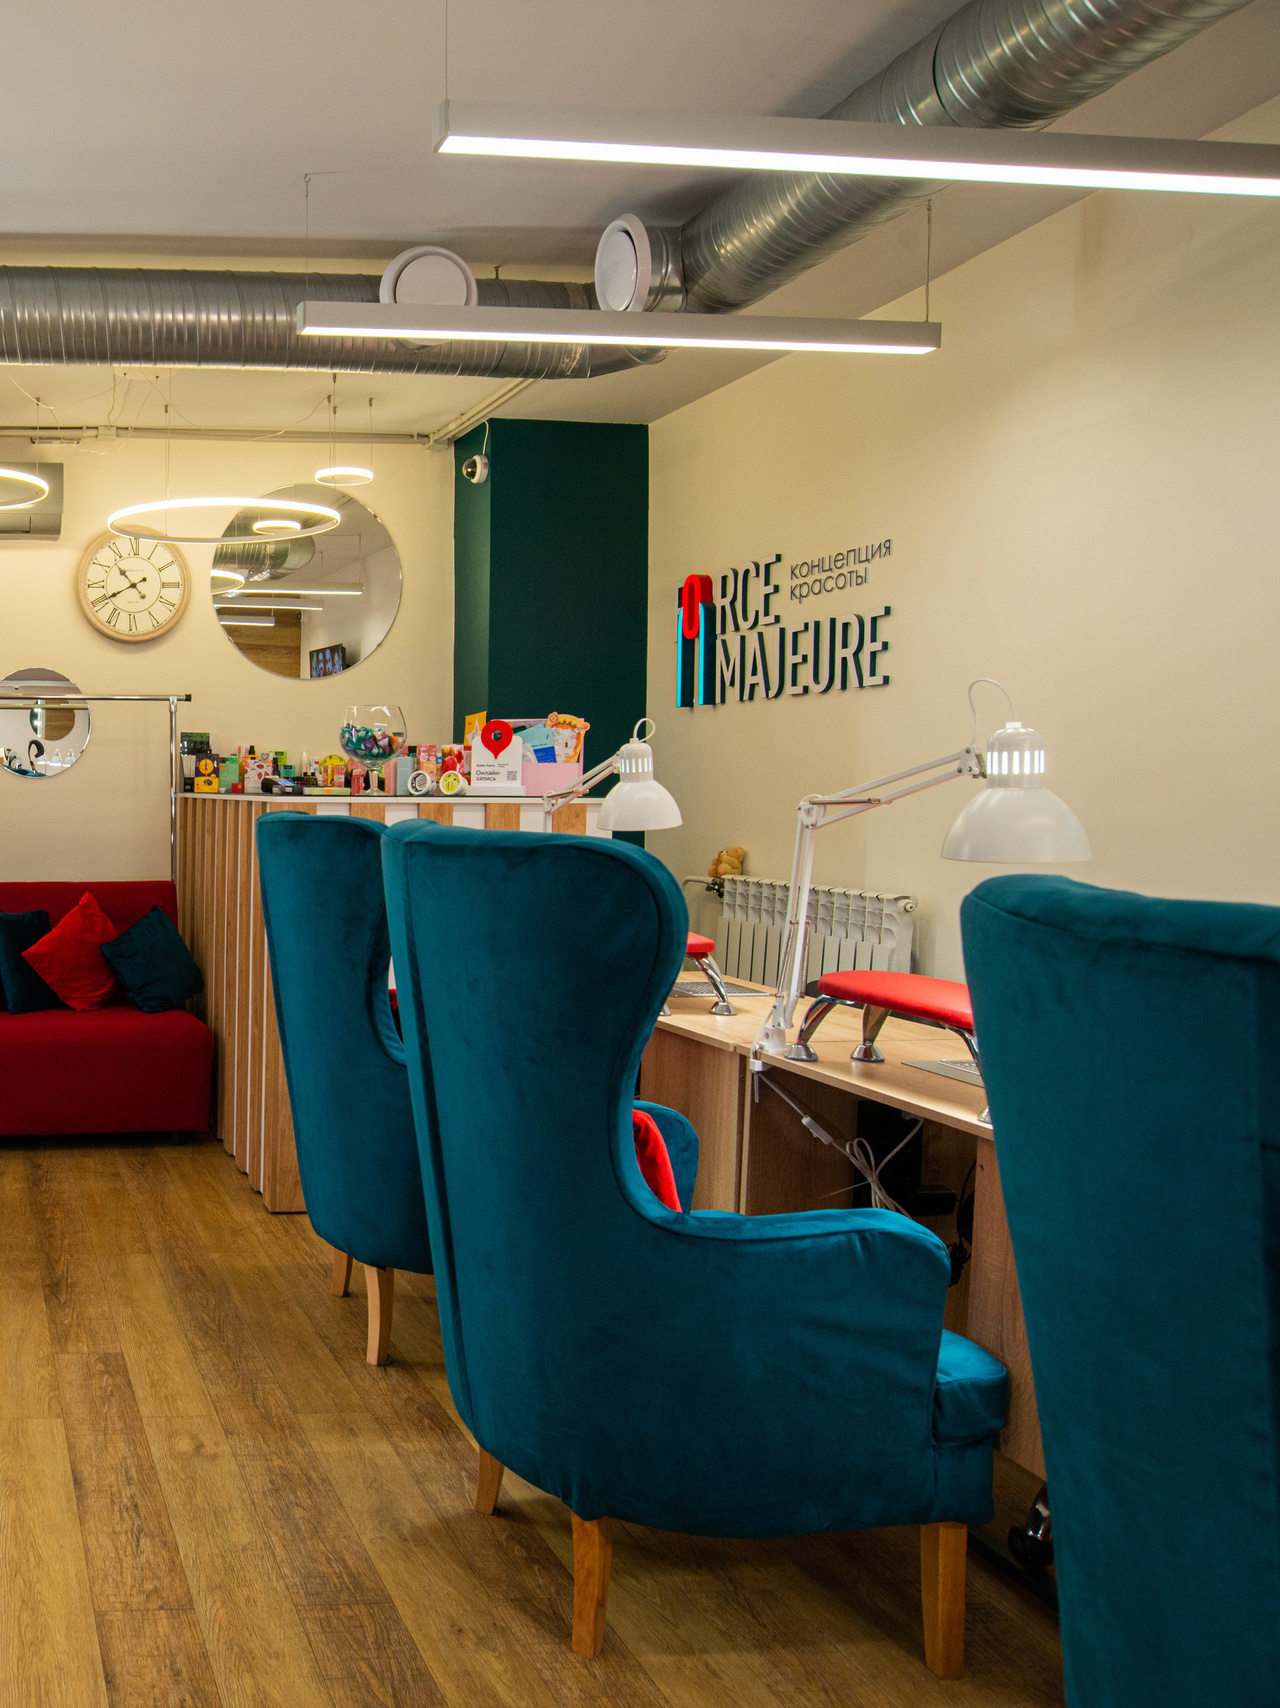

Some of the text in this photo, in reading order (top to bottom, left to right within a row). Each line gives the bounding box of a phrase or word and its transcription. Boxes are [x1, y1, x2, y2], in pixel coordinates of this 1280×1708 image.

[789, 538, 892, 581] концепция
[789, 567, 869, 604] красоты
[716, 605, 891, 705] MAJEURE
